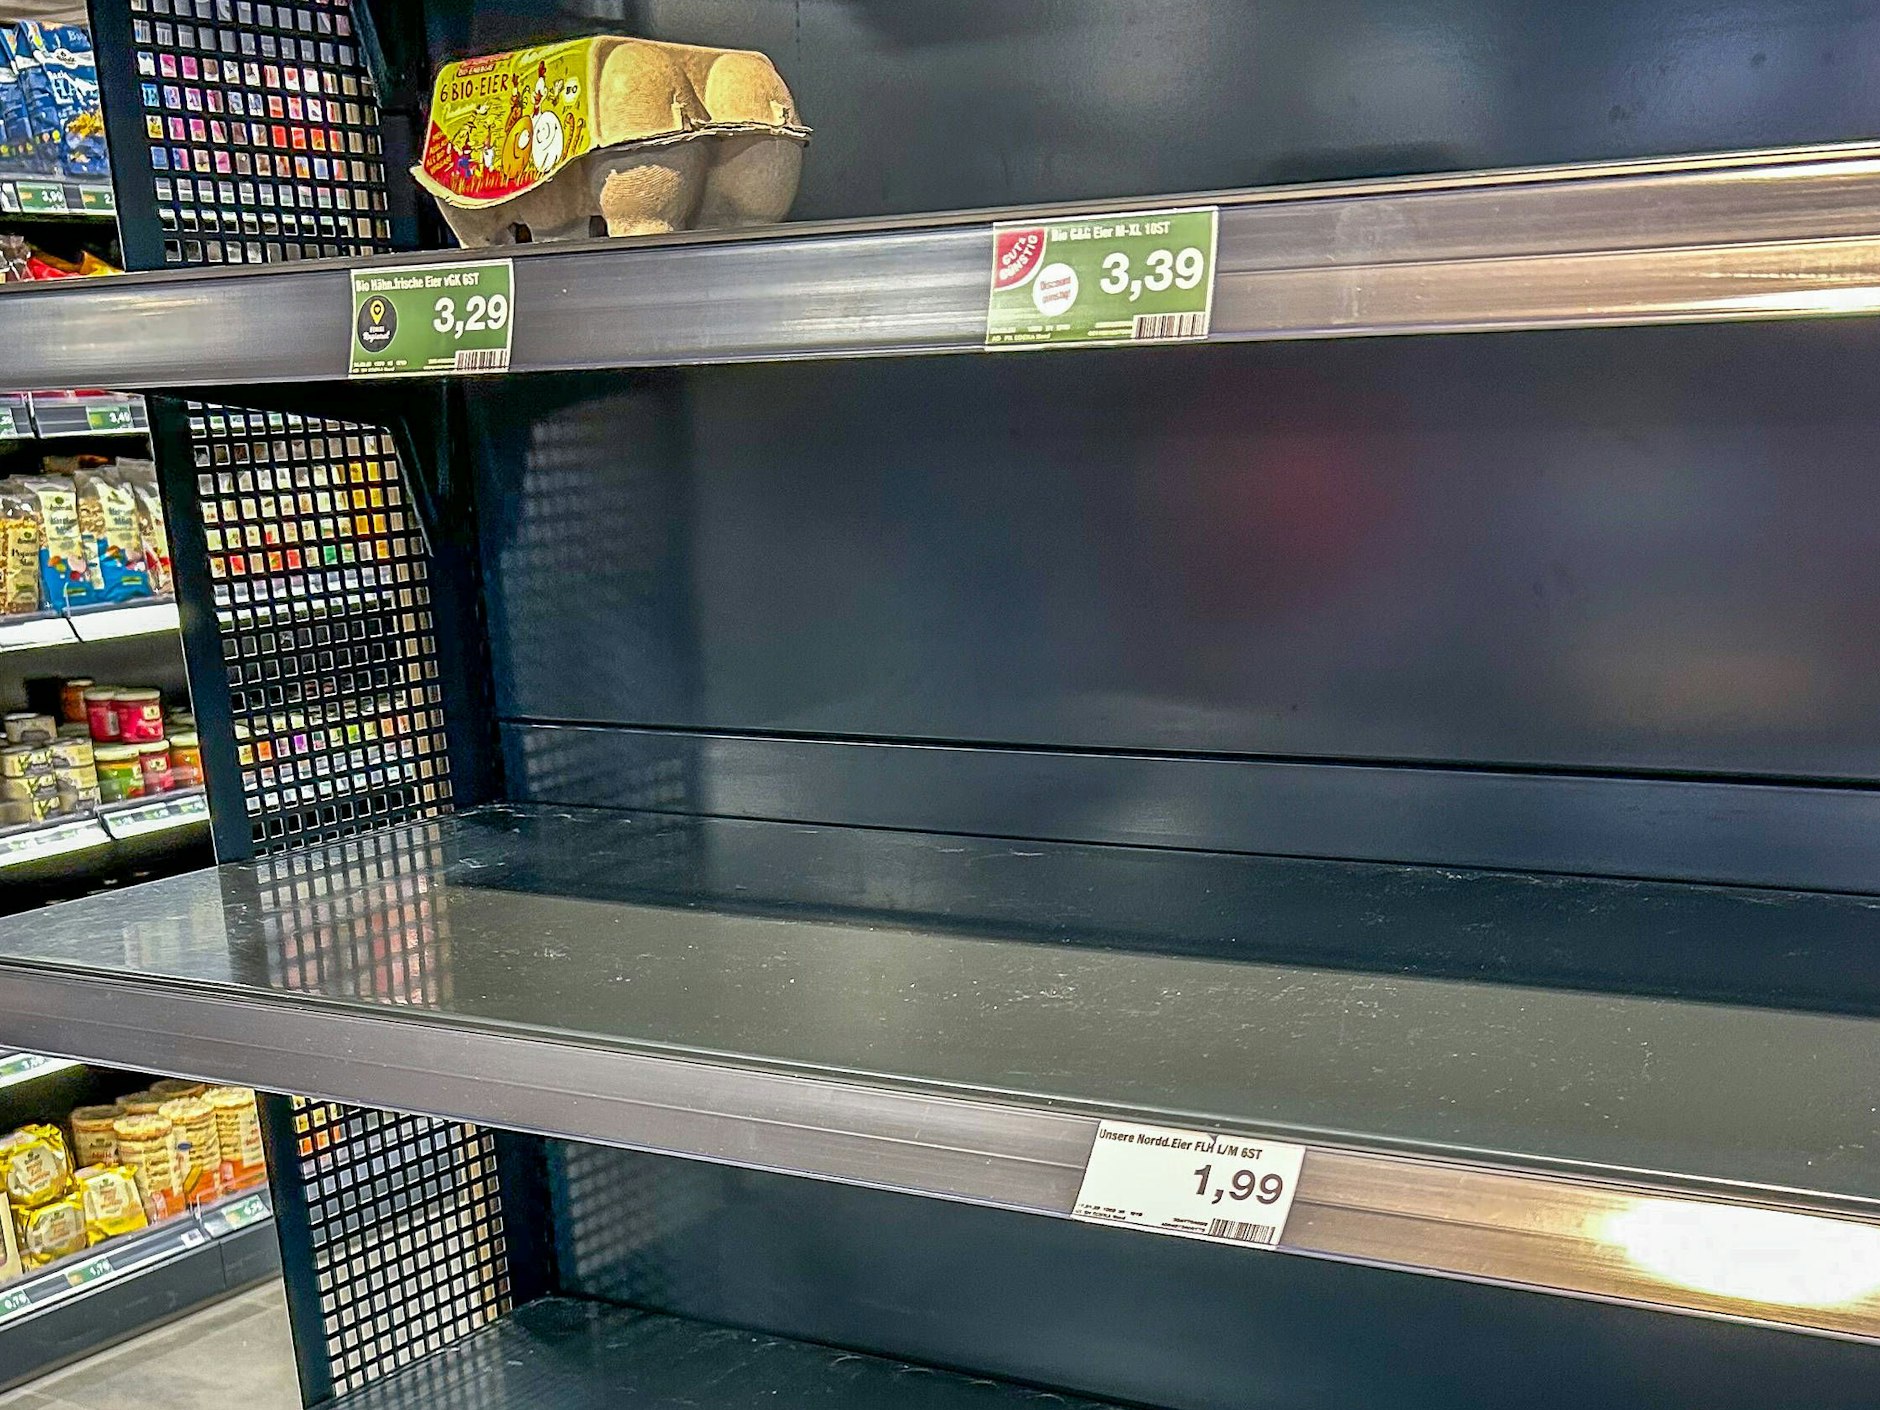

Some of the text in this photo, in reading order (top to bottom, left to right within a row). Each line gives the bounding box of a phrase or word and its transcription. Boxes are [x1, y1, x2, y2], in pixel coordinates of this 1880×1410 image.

[440, 86, 448, 103] 6
[1051, 228, 1067, 242] Bio
[1093, 225, 1113, 239] Eier
[1144, 221, 1171, 235] 10ST
[355, 279, 370, 292] Bio
[424, 275, 442, 288] Eier
[1100, 247, 1204, 302] 3,39
[433, 294, 508, 340] 3,29
[1098, 1128, 1263, 1160] Unsere Nordd.Eier FLH L/M 6ST
[1194, 1164, 1283, 1205] 1,99
